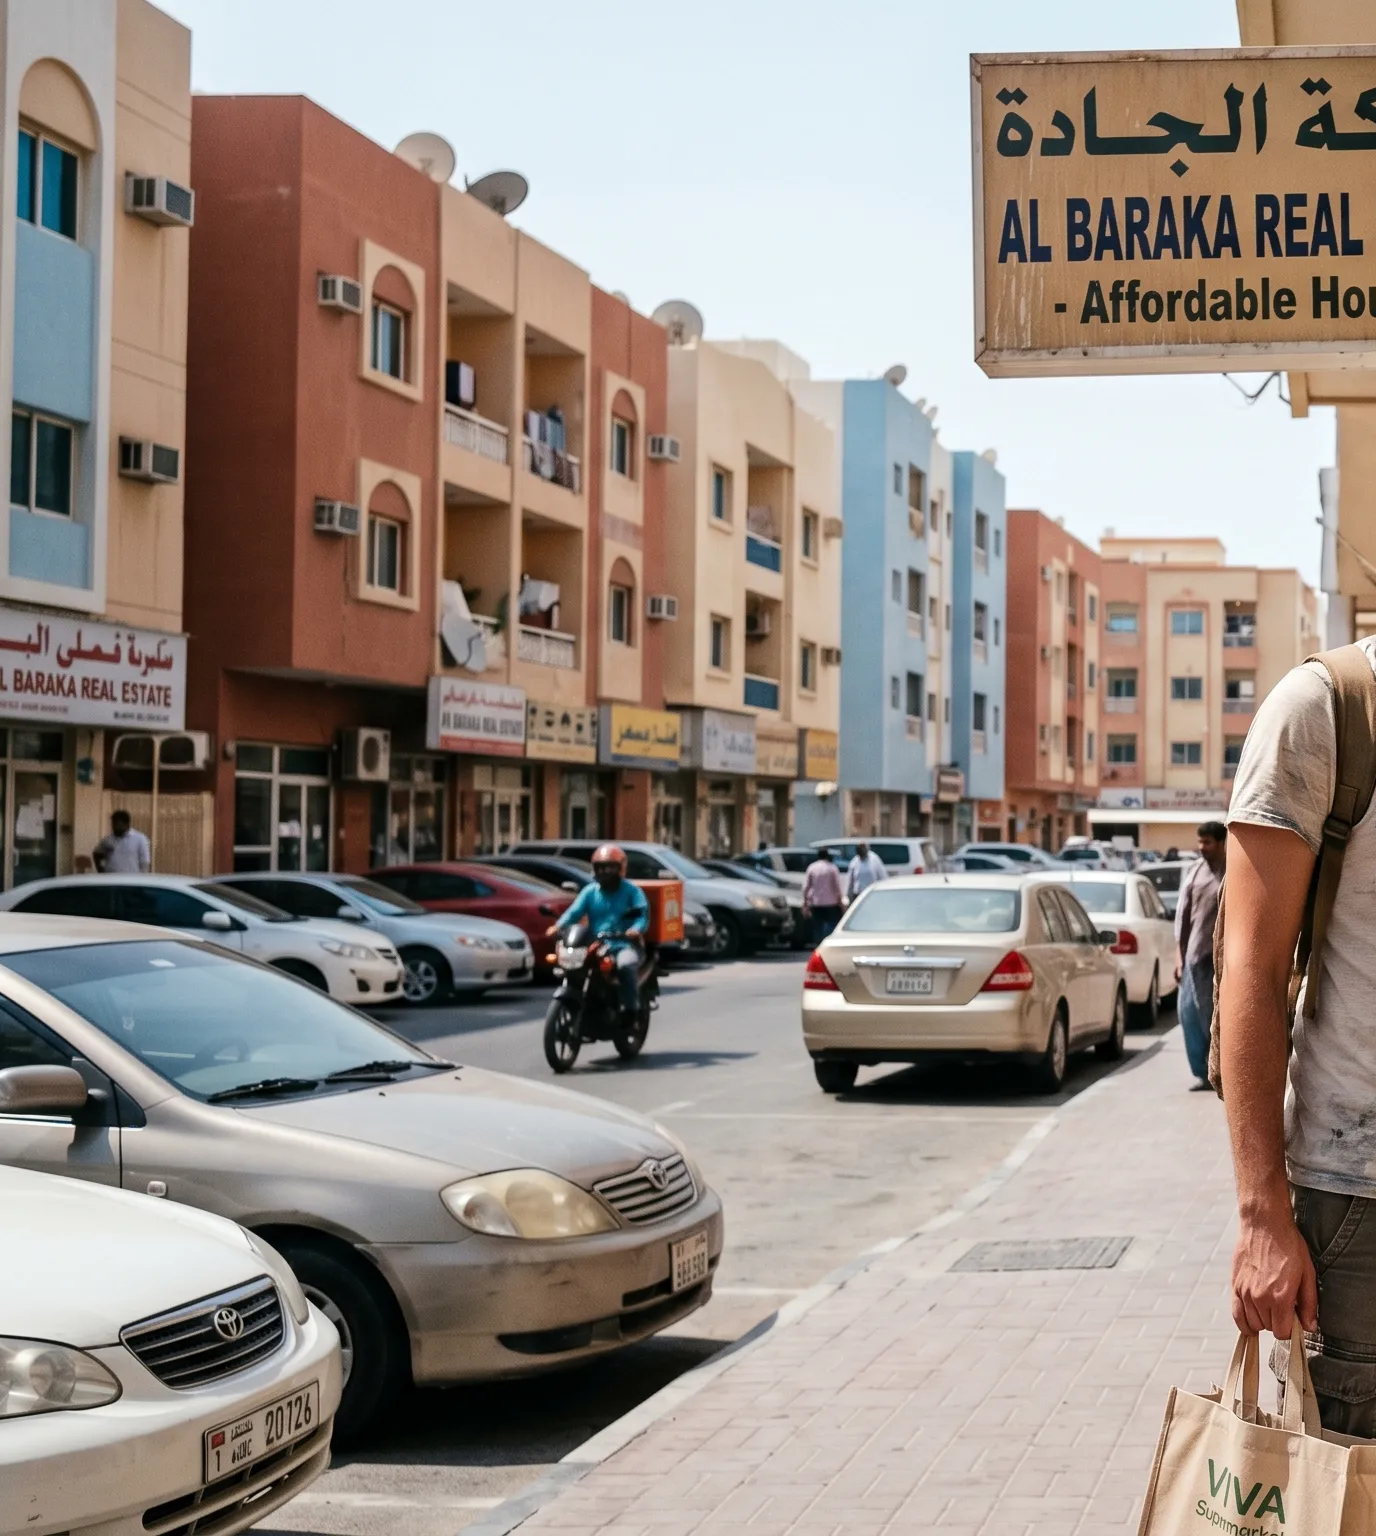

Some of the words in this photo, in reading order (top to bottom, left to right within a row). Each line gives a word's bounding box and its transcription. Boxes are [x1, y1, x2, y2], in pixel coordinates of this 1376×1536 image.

[996, 81, 1268, 178] الجادة
[999, 198, 1052, 264] AL
[1067, 194, 1241, 261] BARAKA
[1256, 191, 1363, 257] REAL
[1081, 277, 1297, 324] Affordable
[0, 667, 7, 691] L
[14, 669, 77, 698] BARAKA
[82, 676, 117, 702] REAL
[122, 682, 172, 708] ESTATE
[1208, 1458, 1286, 1525] VIVA
